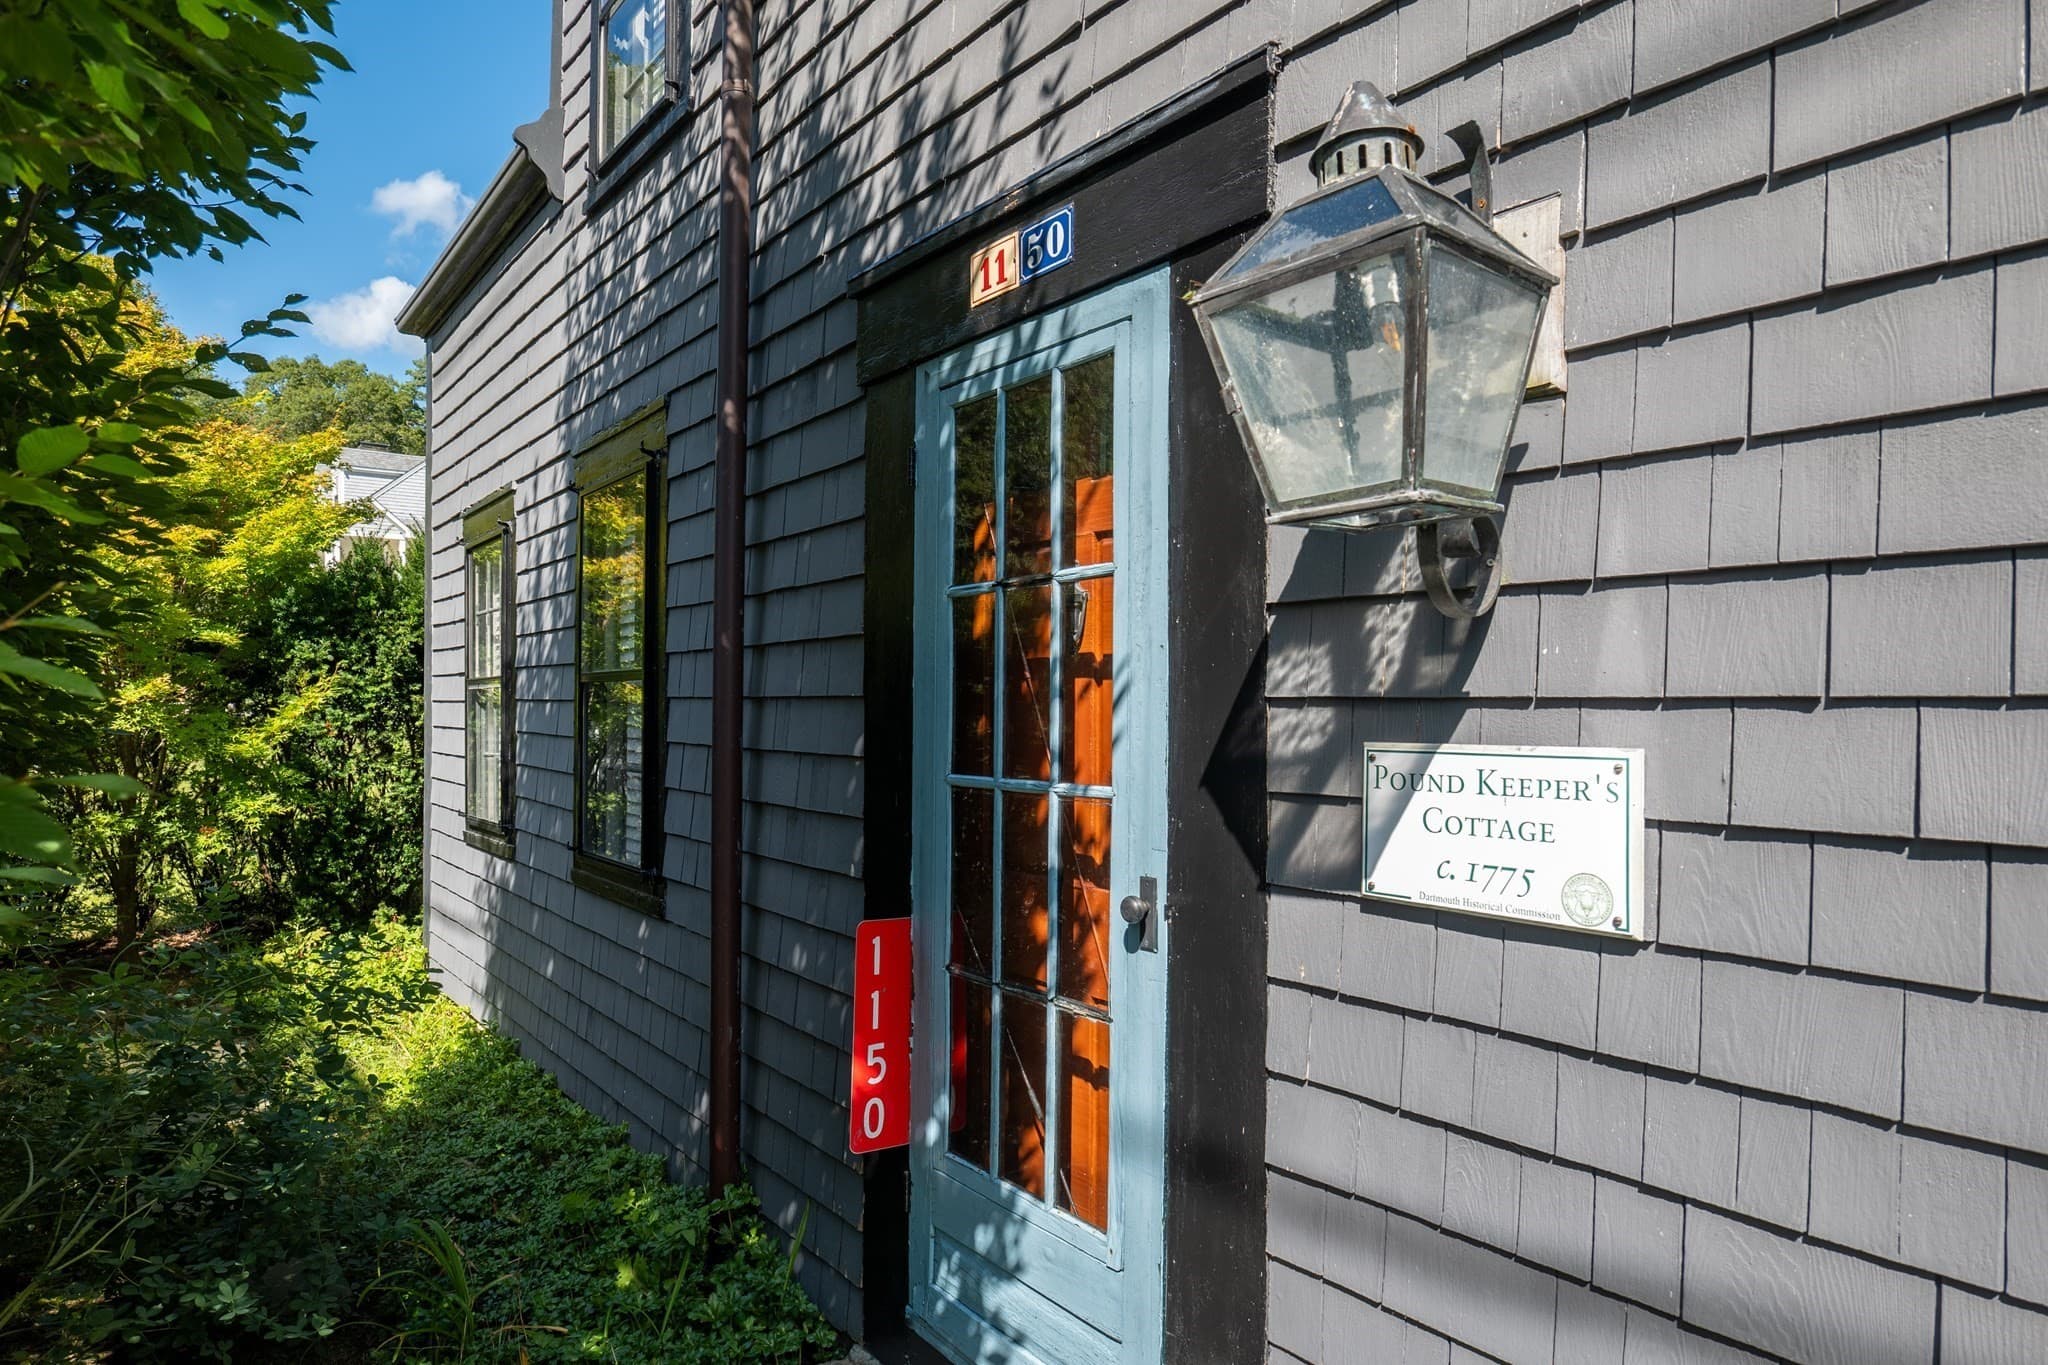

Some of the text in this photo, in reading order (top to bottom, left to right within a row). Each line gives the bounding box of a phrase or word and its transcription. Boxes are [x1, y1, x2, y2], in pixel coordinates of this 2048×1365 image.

[980, 221, 1064, 293] 11 50
[1373, 764, 1620, 803] POUND KEEPER'S
[1422, 807, 1556, 843] COTTAGE
[1465, 862, 1536, 898] 1775
[1419, 891, 1561, 921] Dartmouth Historical Commission
